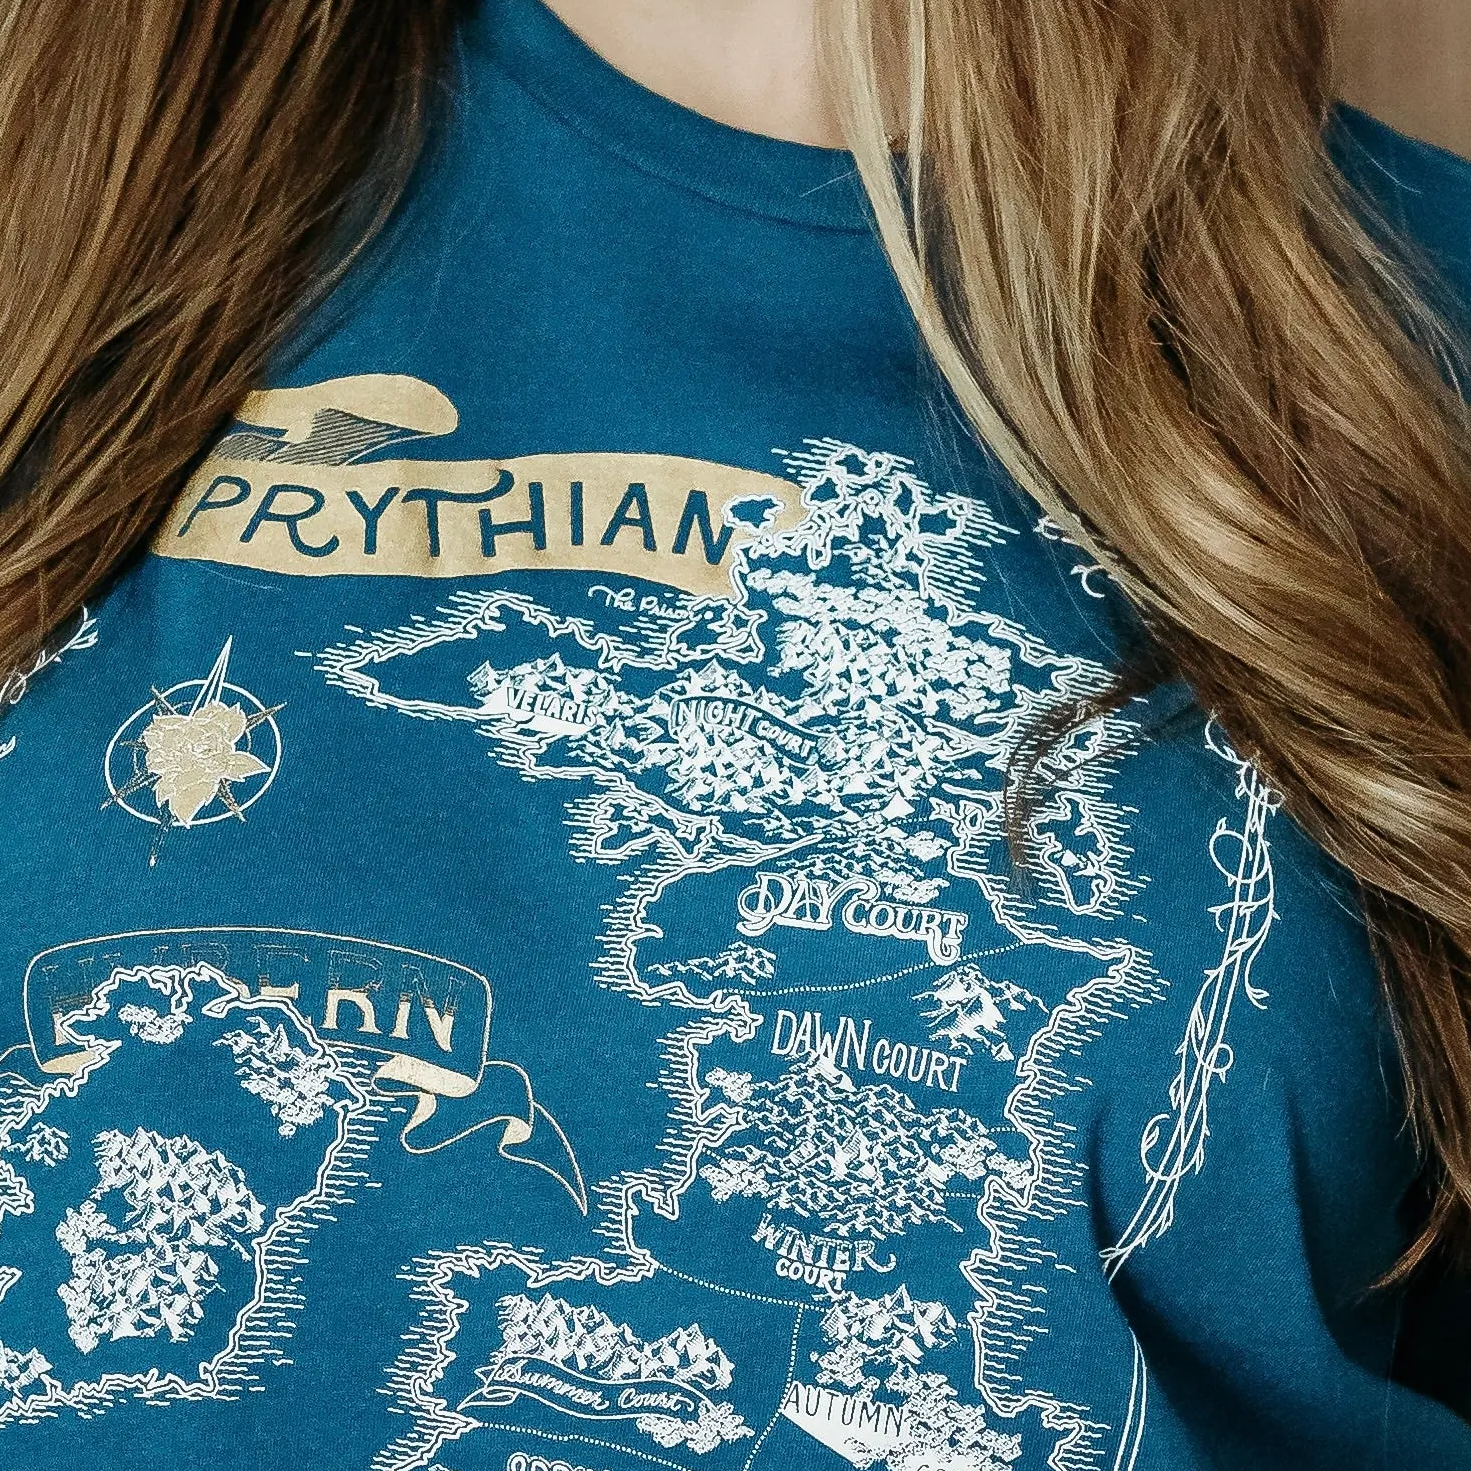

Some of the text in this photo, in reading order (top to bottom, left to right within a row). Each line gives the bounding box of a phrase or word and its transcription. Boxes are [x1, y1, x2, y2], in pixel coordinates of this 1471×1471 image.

[178, 468, 734, 566] PRYTHIAN
[588, 585, 636, 612] The
[506, 686, 599, 727] VELARIS
[677, 699, 819, 758] NIGHT COURT
[737, 872, 968, 965] DAY COURT
[771, 1009, 968, 1093] DAWN COURT
[751, 1213, 897, 1273] WINTER
[775, 1257, 848, 1301] COURT
[496, 1358, 695, 1412] Summer Court
[783, 1383, 905, 1438] AUTUMN
